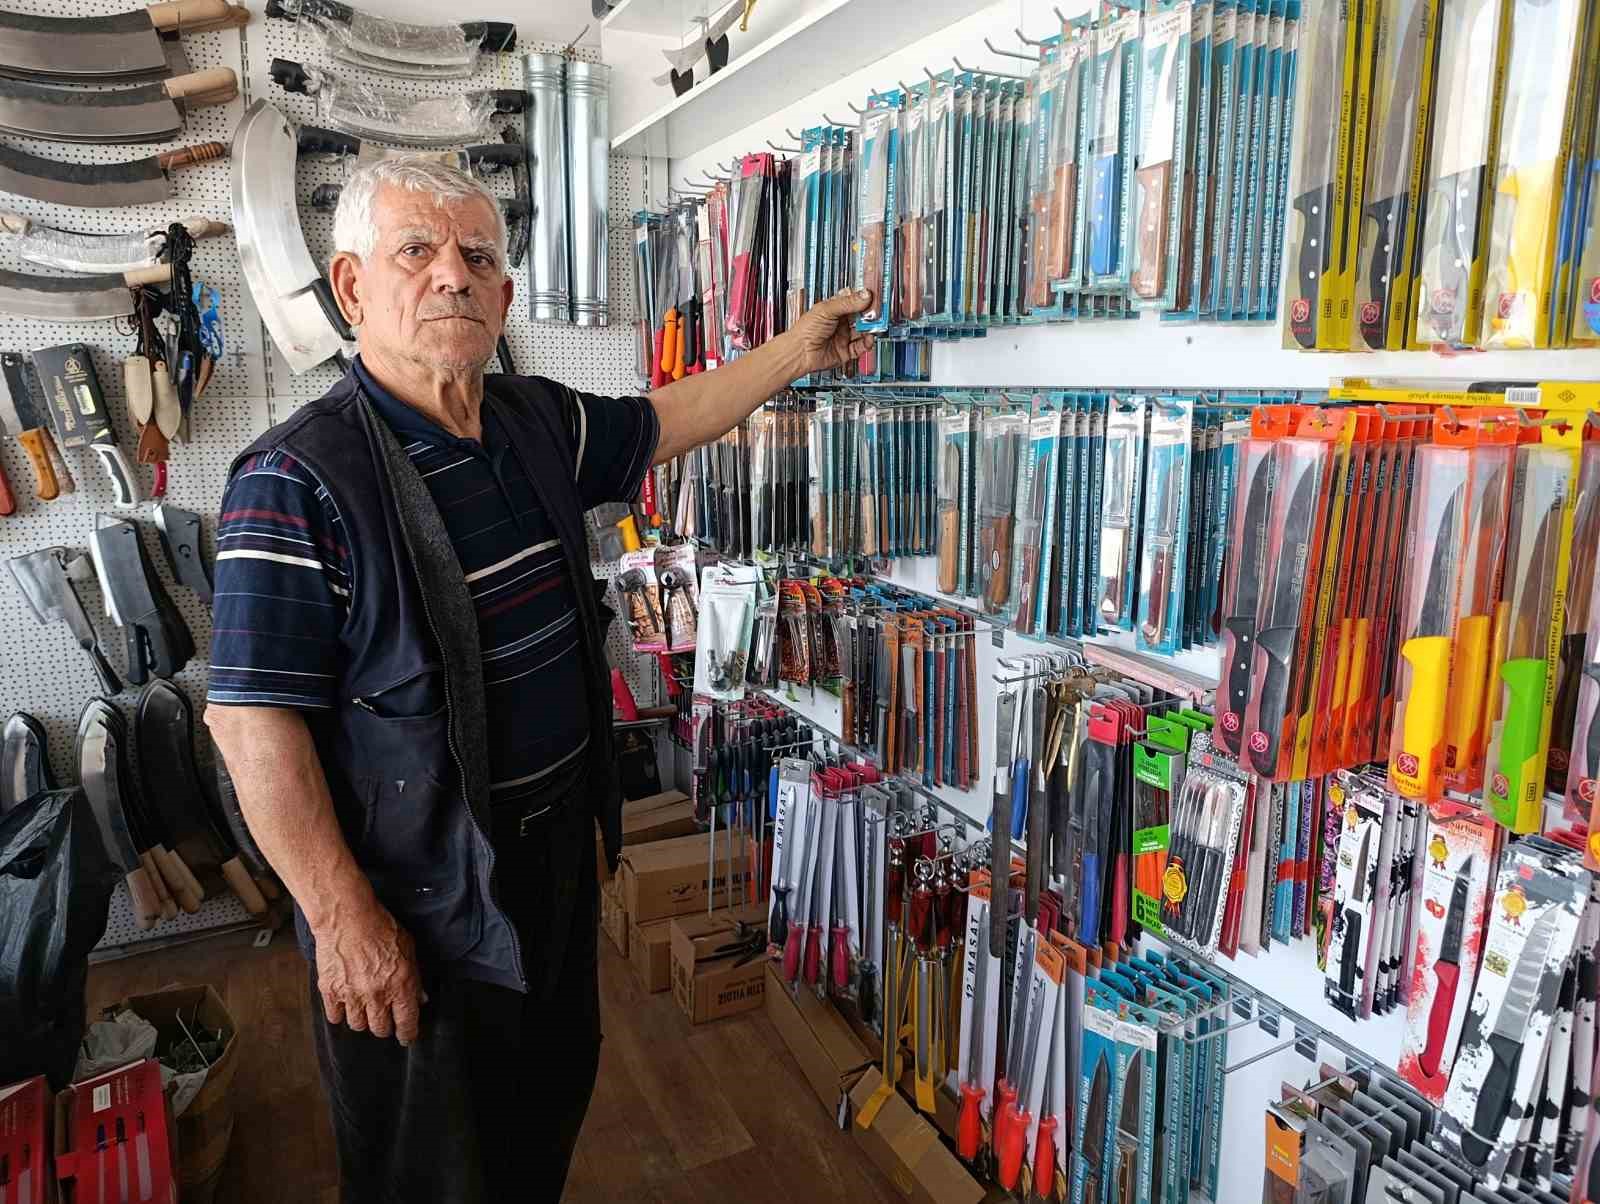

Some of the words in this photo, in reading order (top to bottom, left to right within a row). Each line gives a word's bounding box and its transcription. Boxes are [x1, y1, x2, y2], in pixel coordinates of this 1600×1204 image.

[777, 788, 786, 836] MASAT
[1136, 894, 1145, 921] 6
[967, 914, 979, 975] MASAT
